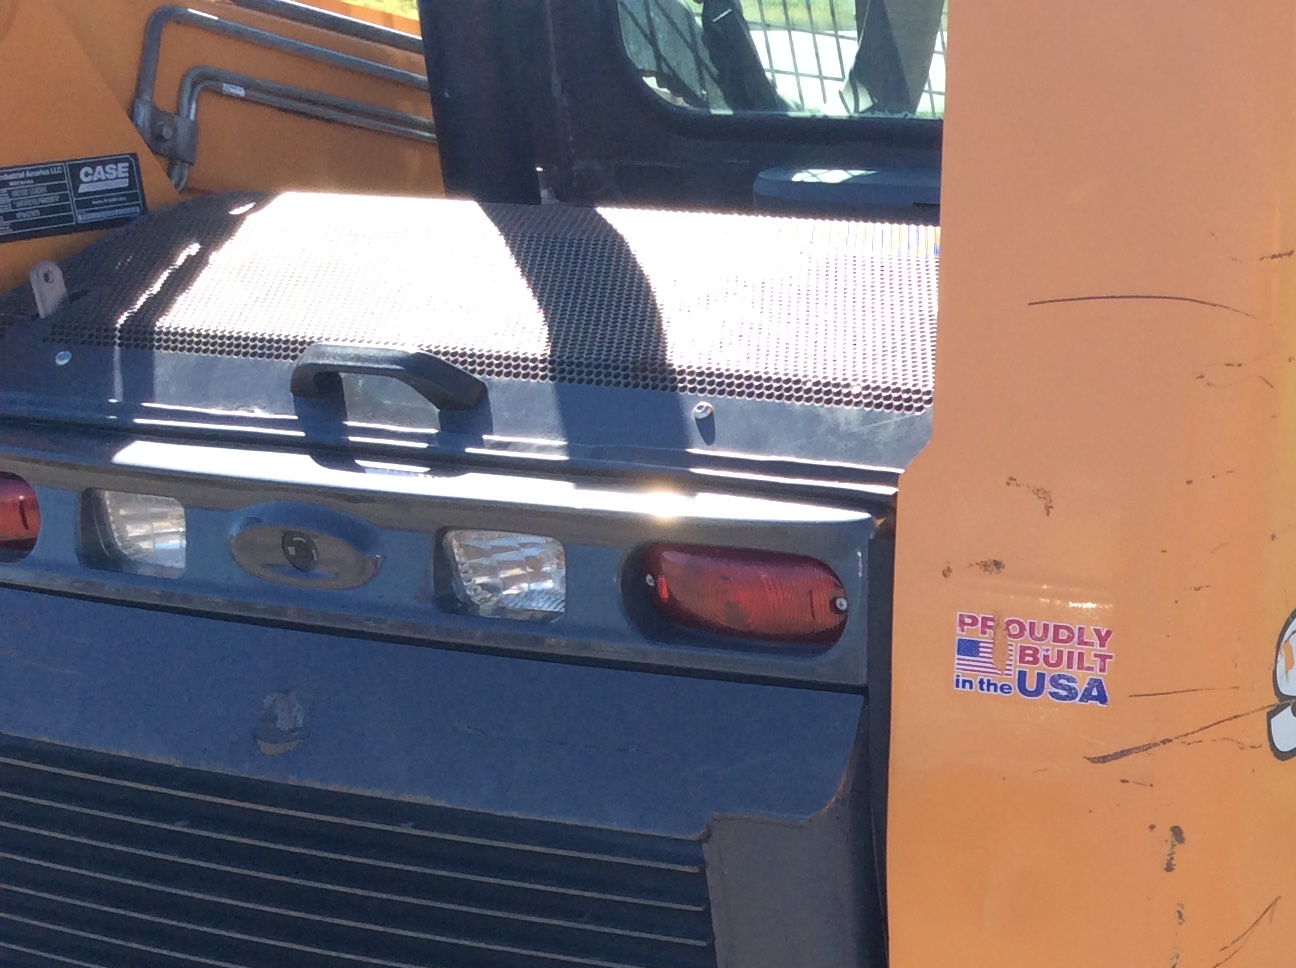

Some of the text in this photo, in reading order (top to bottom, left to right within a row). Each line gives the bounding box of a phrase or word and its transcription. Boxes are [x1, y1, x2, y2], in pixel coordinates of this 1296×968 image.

[50, 166, 62, 174] LLC
[79, 162, 130, 182] CASE
[1018, 644, 1114, 675] BUILT
[954, 669, 1110, 707] in the USA
